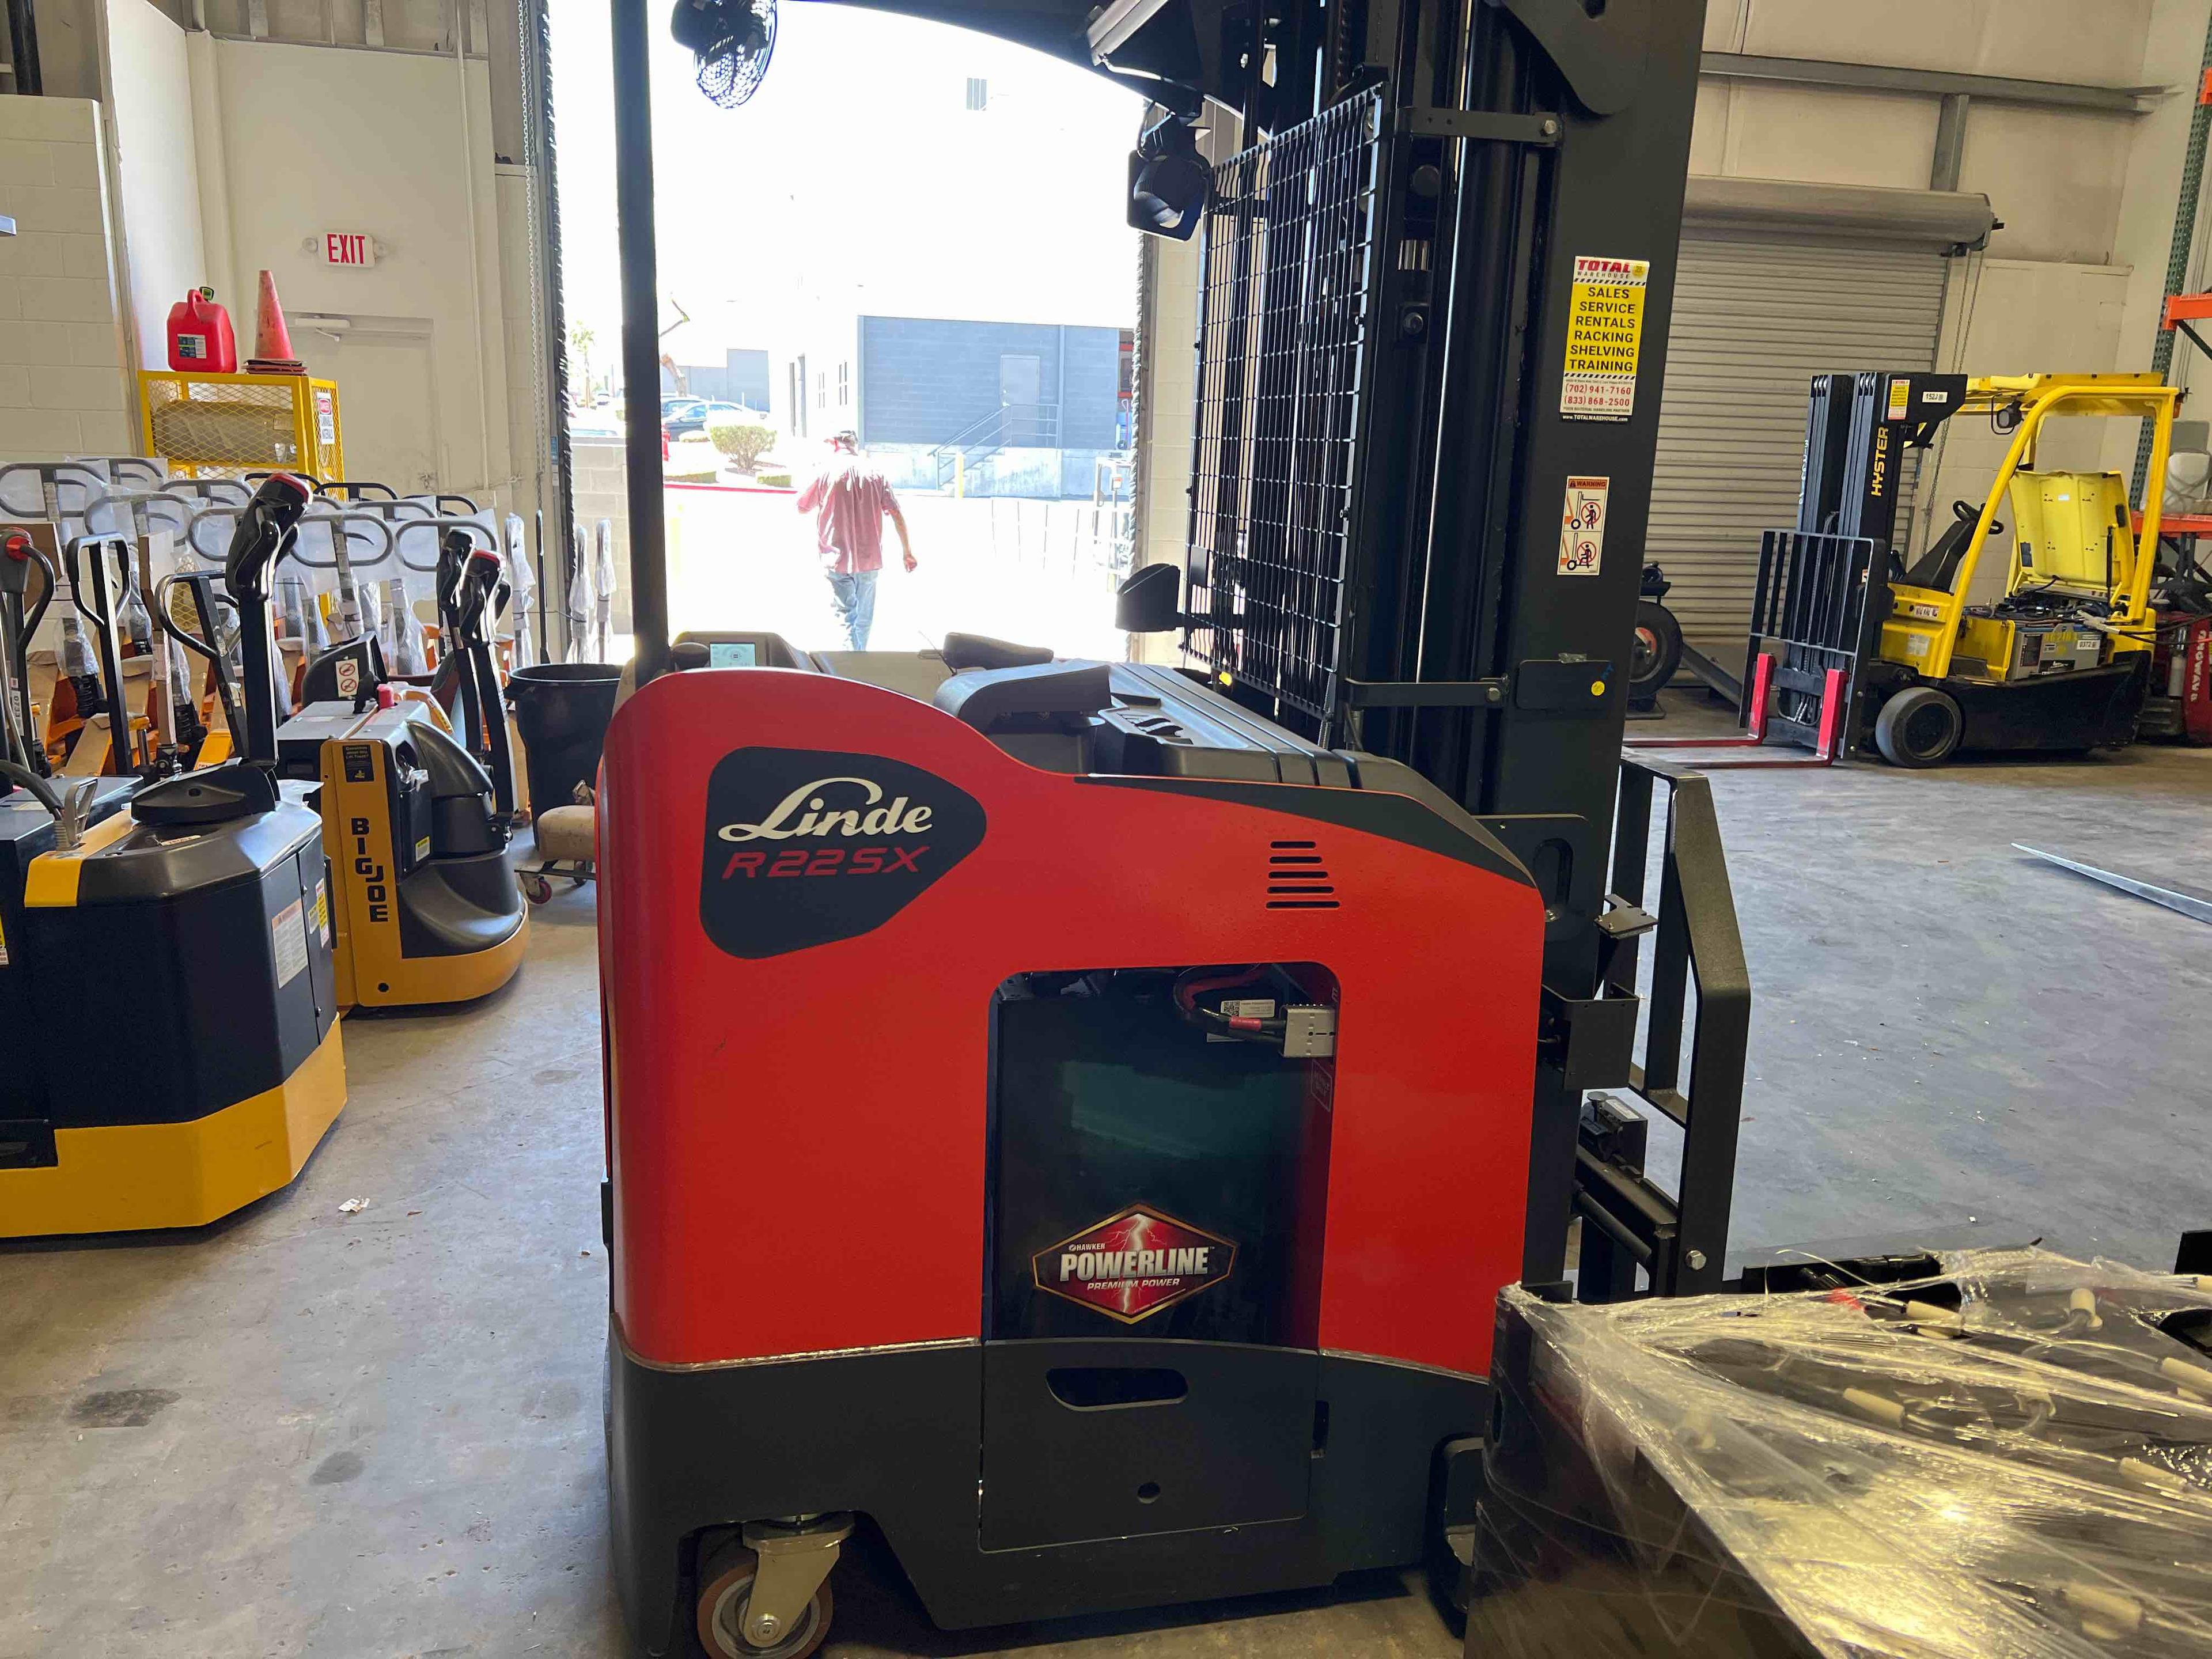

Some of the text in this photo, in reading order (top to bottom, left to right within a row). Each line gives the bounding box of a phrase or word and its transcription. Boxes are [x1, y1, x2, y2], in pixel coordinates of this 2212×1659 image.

[327, 233, 365, 264] EXIT
[1578, 260, 1631, 273] TOTAL
[1577, 271, 1631, 279] WAREHOUSE
[1588, 287, 1630, 299] SALES
[1579, 301, 1636, 314] SERVICE
[1575, 316, 1635, 328] RENTALS
[1574, 330, 1634, 343] RACKING
[1570, 344, 1634, 357] SHELVING
[1569, 359, 1633, 372] TRAINING
[1565, 383, 1631, 395] (702) 941-7160
[1564, 395, 1630, 407] (833) 868-2500
[1870, 426, 1889, 497] HYSTER
[718, 777, 933, 842] Linde
[1059, 1246, 1209, 1282] POWERLINE
[1087, 1278, 1181, 1291] PREMIUM POWER
